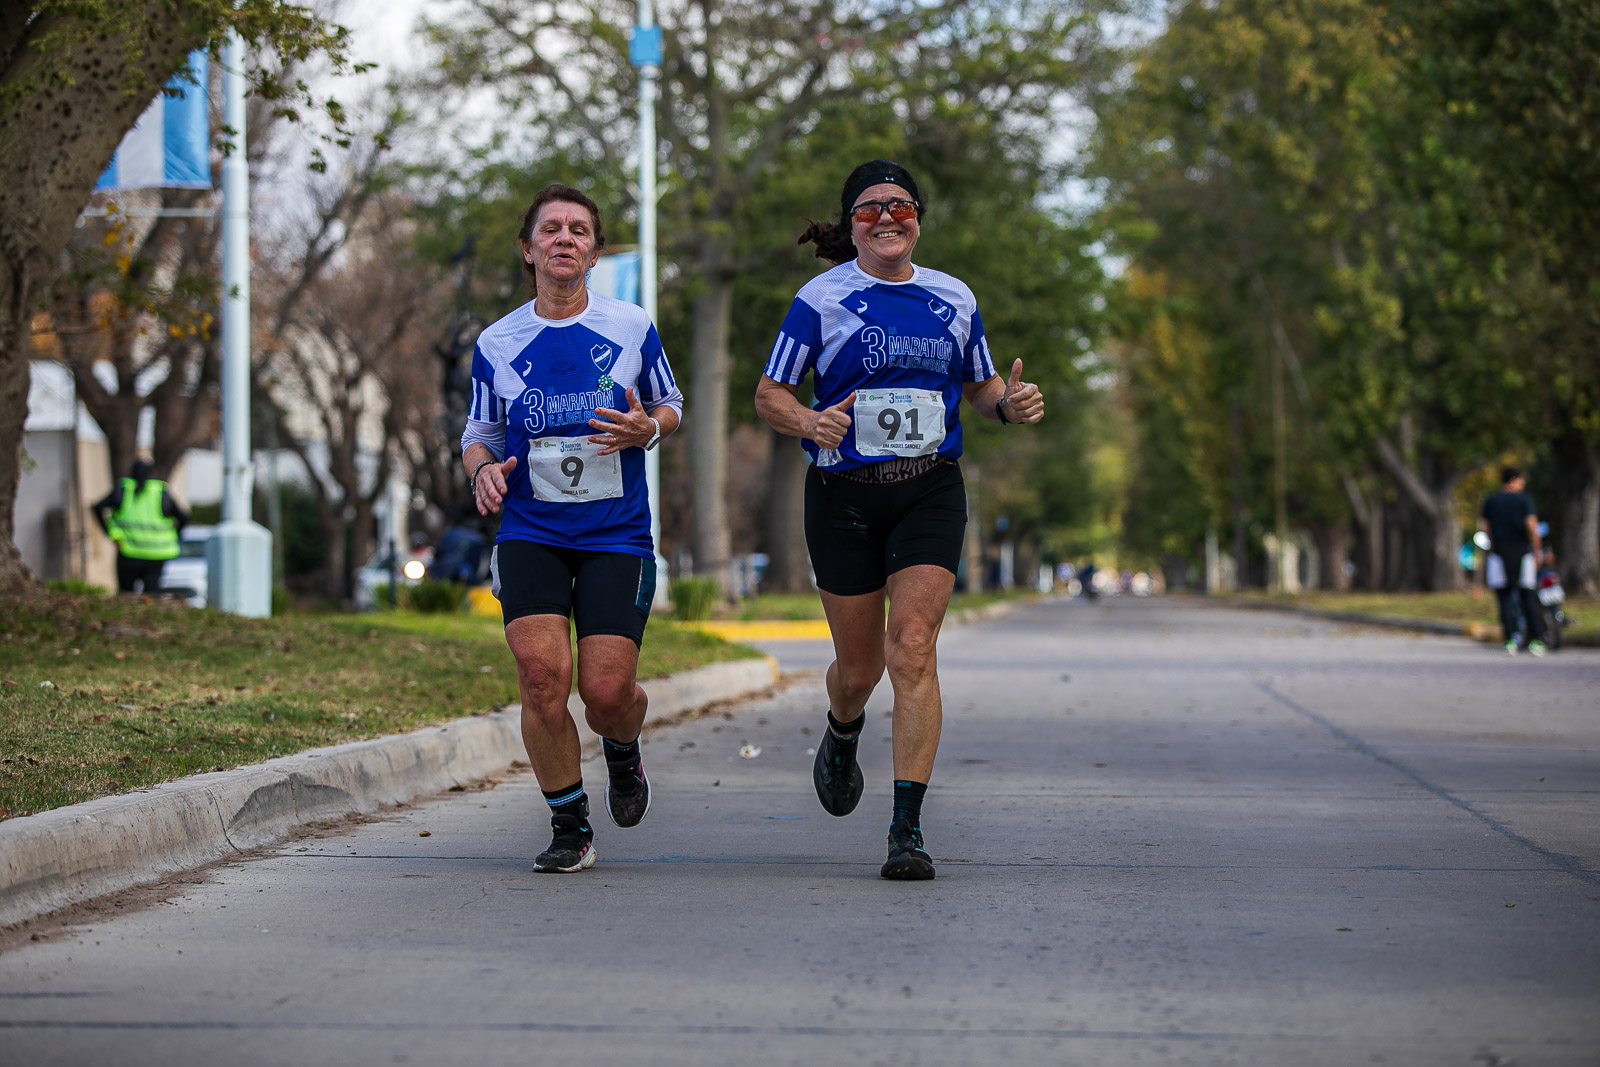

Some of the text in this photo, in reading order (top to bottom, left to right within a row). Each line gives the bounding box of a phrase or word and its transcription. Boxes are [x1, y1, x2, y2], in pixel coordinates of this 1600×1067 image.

[861, 326, 952, 375] 3 MARATÓN
[523, 388, 546, 434] 3
[888, 392, 895, 404] 3
[877, 408, 924, 441] 91
[560, 441, 565, 452] 3
[560, 455, 585, 488] 9
